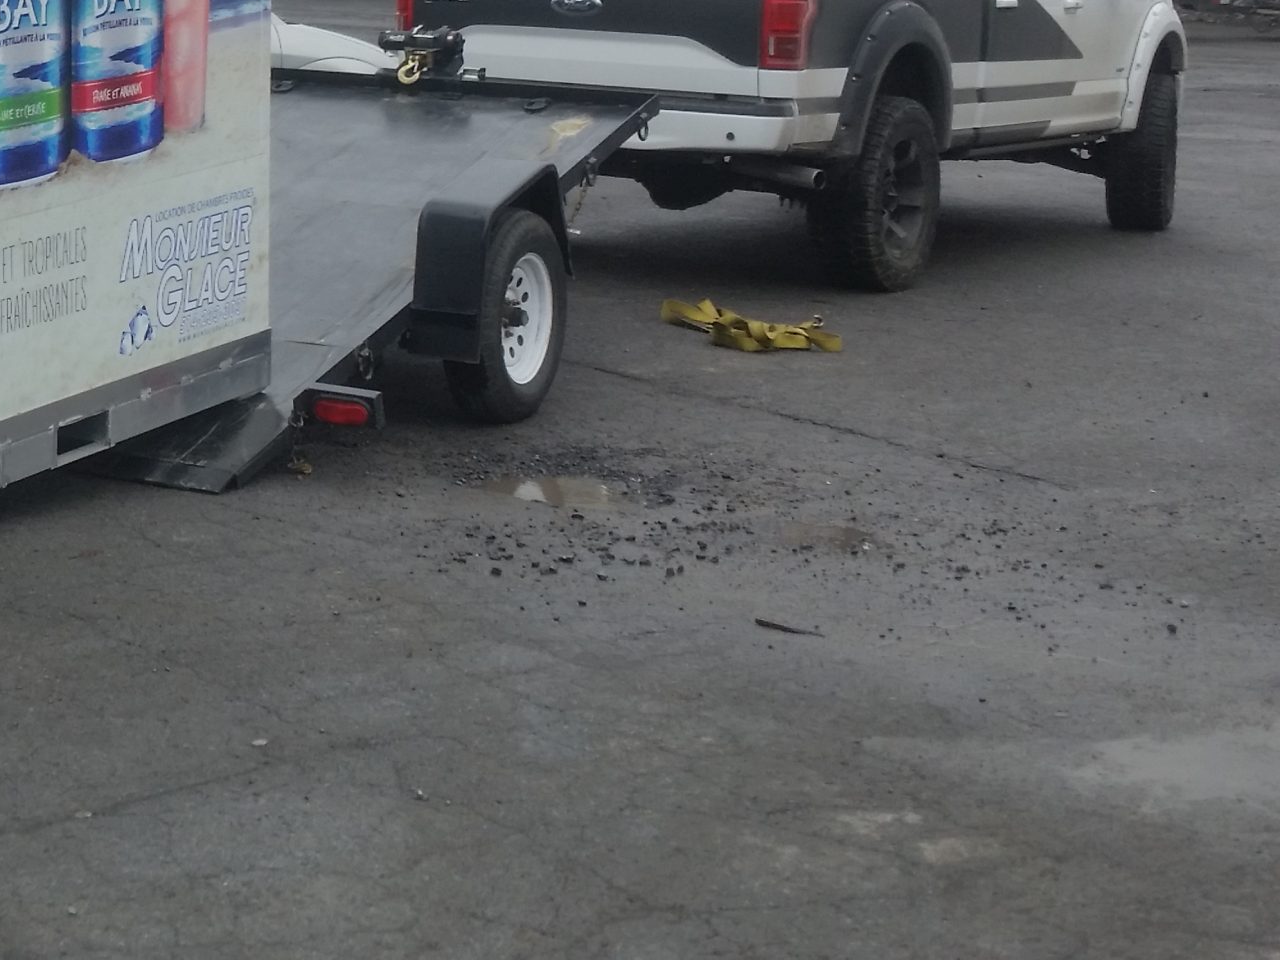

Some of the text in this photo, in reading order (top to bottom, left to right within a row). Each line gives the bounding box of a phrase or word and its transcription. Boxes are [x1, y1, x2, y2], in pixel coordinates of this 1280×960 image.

[119, 204, 253, 283] MONSIEUR
[154, 205, 186, 223] LOCATION
[2, 244, 16, 284] ET
[21, 226, 87, 278] TROPICALES
[157, 250, 250, 328] GLACE
